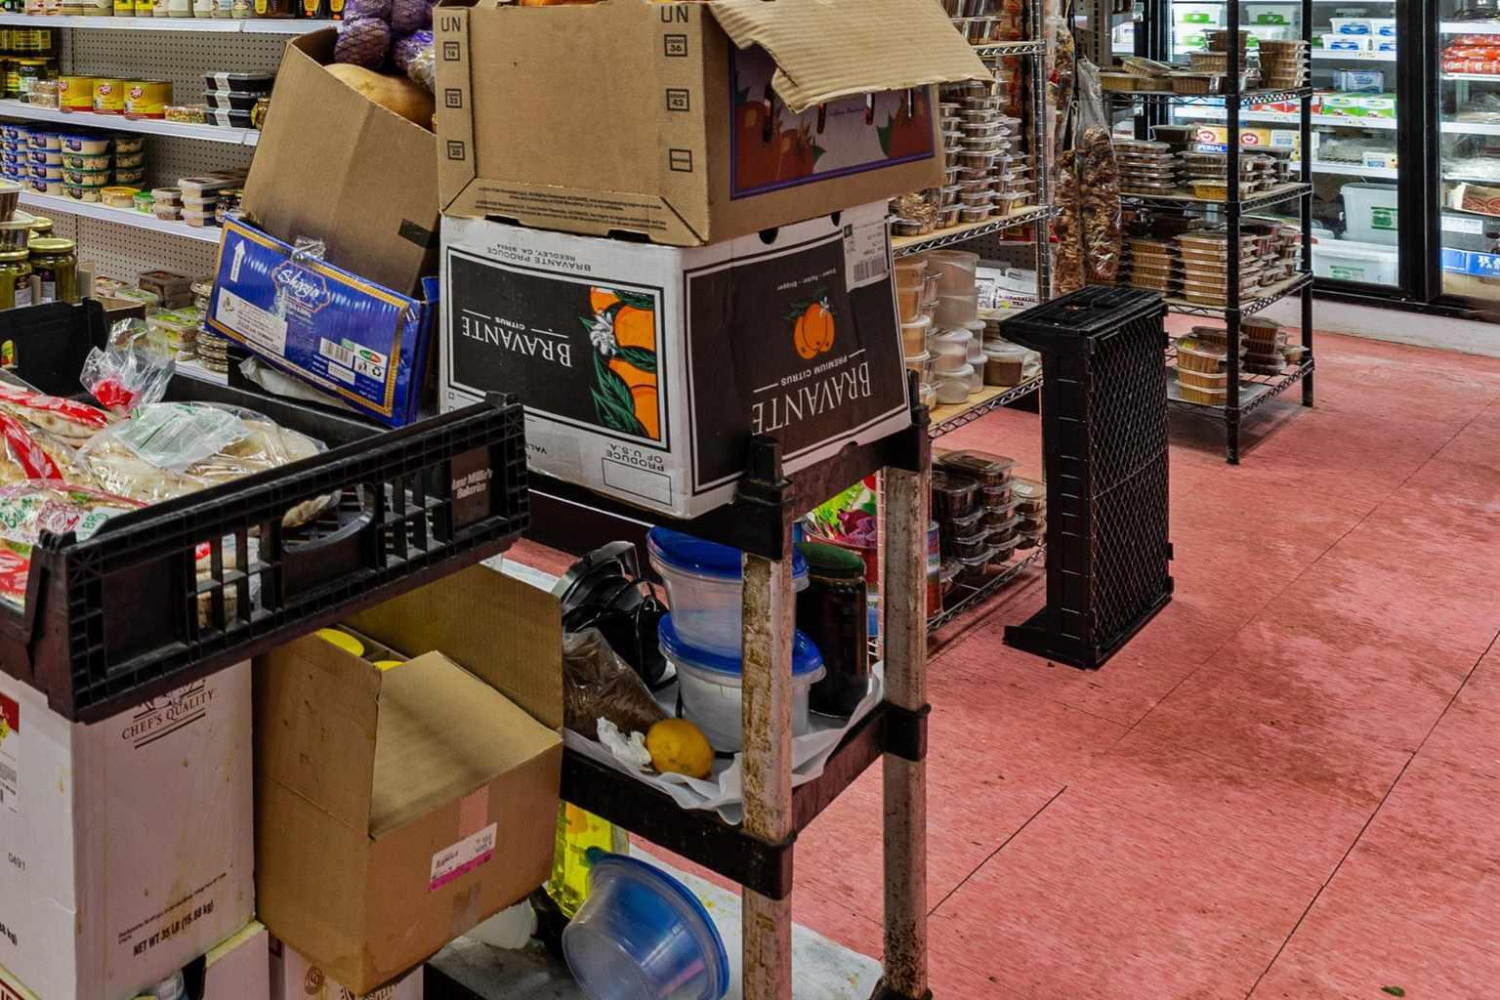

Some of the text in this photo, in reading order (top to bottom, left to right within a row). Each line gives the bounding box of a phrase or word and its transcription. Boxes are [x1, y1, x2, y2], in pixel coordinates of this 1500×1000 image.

[487, 246, 591, 272] BRAVANTE PRODUCE
[495, 317, 525, 330] CITRUS
[462, 316, 572, 367] BRAVANTE
[781, 355, 847, 386] PREMIUM CITRUS
[752, 361, 871, 436] BRAVANTE
[606, 450, 665, 471] PRODUCE
[122, 689, 214, 740] CHEF'S QUALITY
